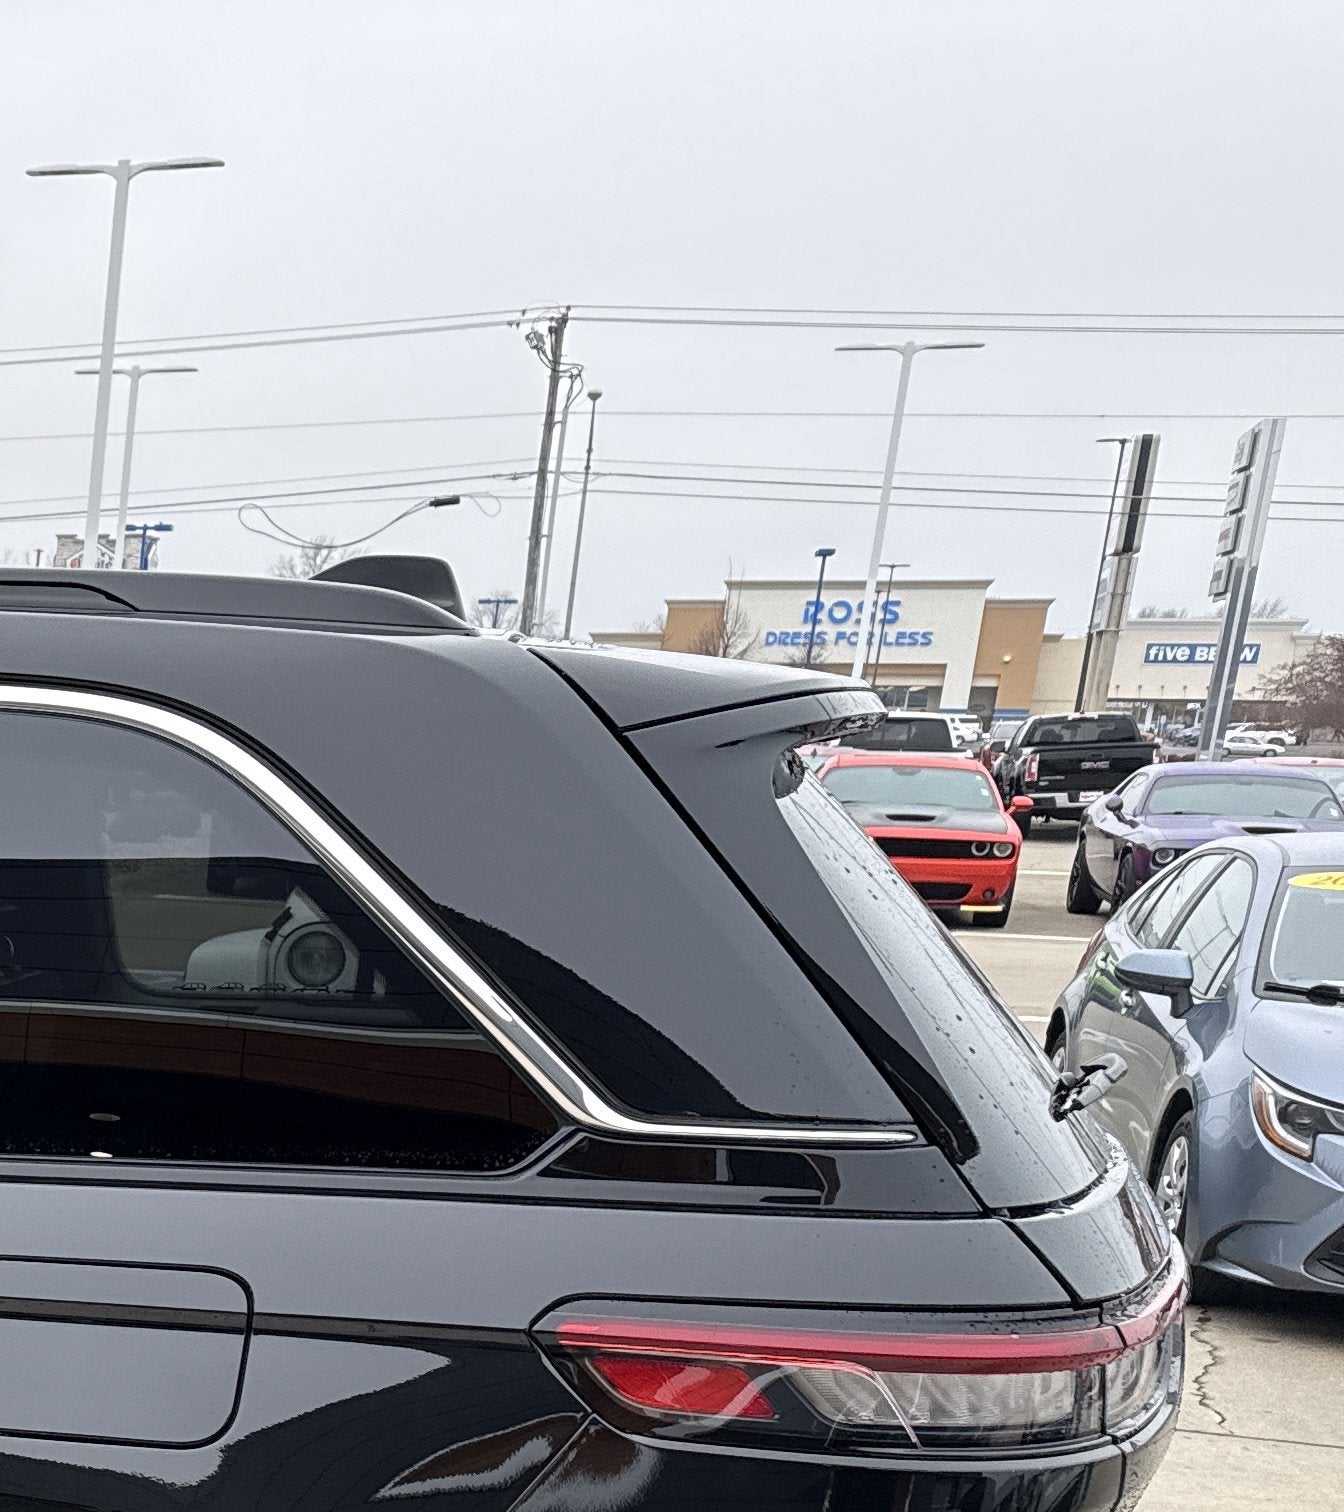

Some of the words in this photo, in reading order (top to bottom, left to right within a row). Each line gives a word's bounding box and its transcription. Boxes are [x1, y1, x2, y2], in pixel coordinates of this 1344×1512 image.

[765, 631, 828, 646] DRESS
[882, 631, 934, 646] LESS
[1148, 645, 1191, 661] five
[1194, 646, 1257, 661] BEW
